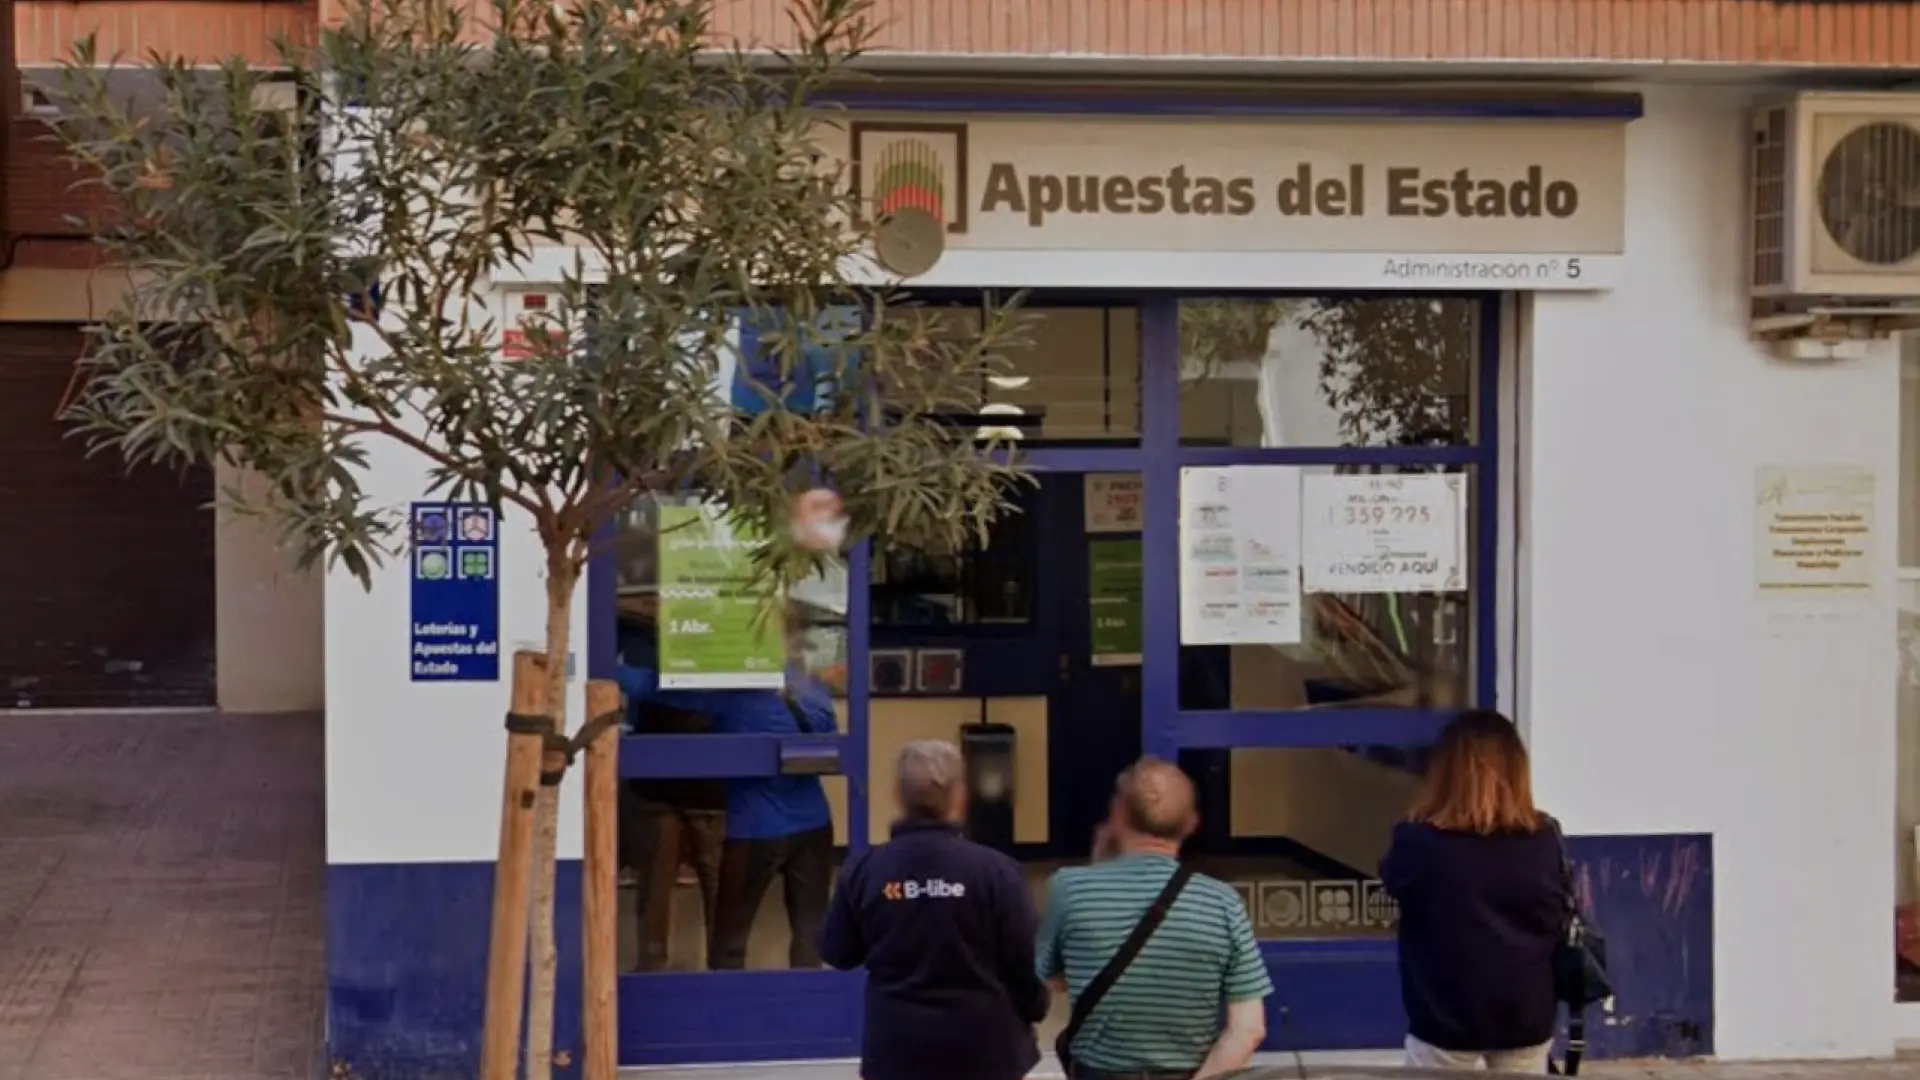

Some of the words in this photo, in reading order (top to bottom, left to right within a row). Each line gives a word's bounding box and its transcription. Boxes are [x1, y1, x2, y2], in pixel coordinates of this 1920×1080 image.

[980, 162, 1256, 226] Apuestas
[1277, 163, 1364, 217] del
[1386, 164, 1580, 219] Estado
[1383, 256, 1531, 280] Administración
[1565, 257, 1582, 279] 5
[468, 623, 480, 639] y
[413, 641, 473, 657] Apuestas
[475, 641, 497, 655] del
[413, 660, 459, 675] Estado
